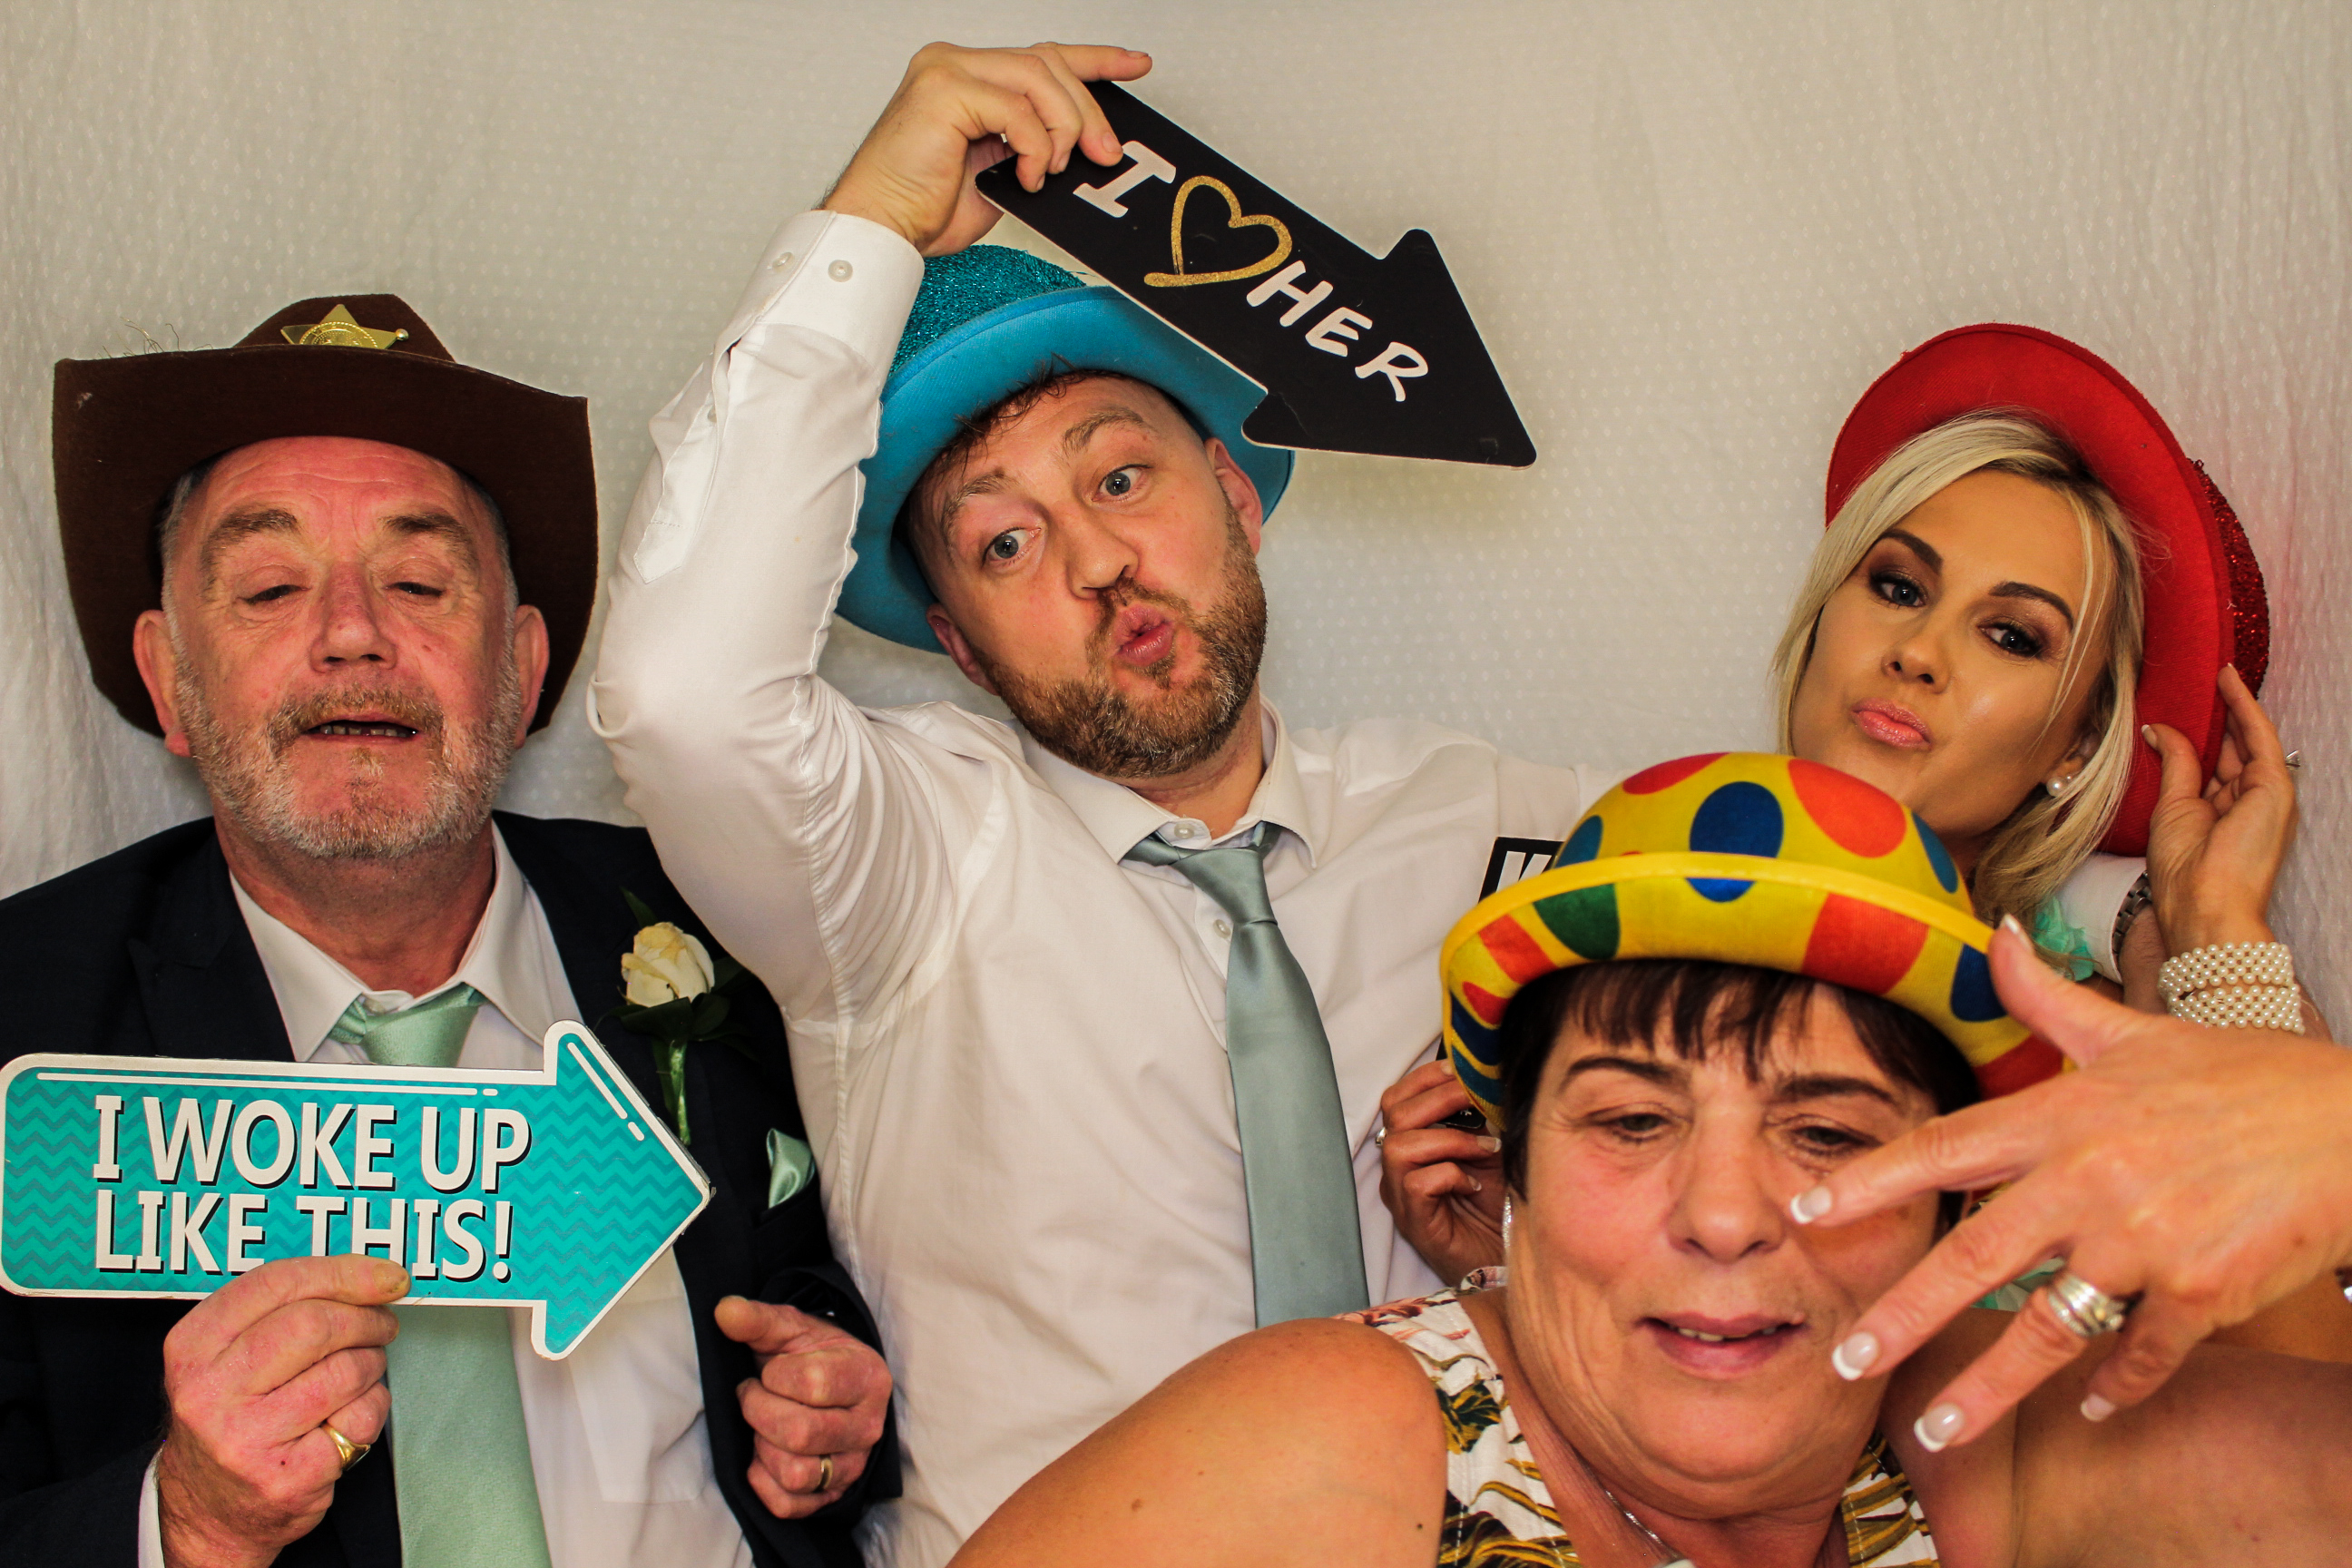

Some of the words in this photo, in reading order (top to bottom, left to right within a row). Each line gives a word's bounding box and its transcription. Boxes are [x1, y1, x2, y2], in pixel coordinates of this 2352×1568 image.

[1073, 140, 1177, 218] I
[1246, 260, 1428, 402] HER
[93, 1095, 122, 1181] I
[142, 1096, 397, 1190] WOKE
[420, 1106, 532, 1193] UP
[93, 1189, 269, 1274] LIKE
[296, 1195, 514, 1282] THIS!
